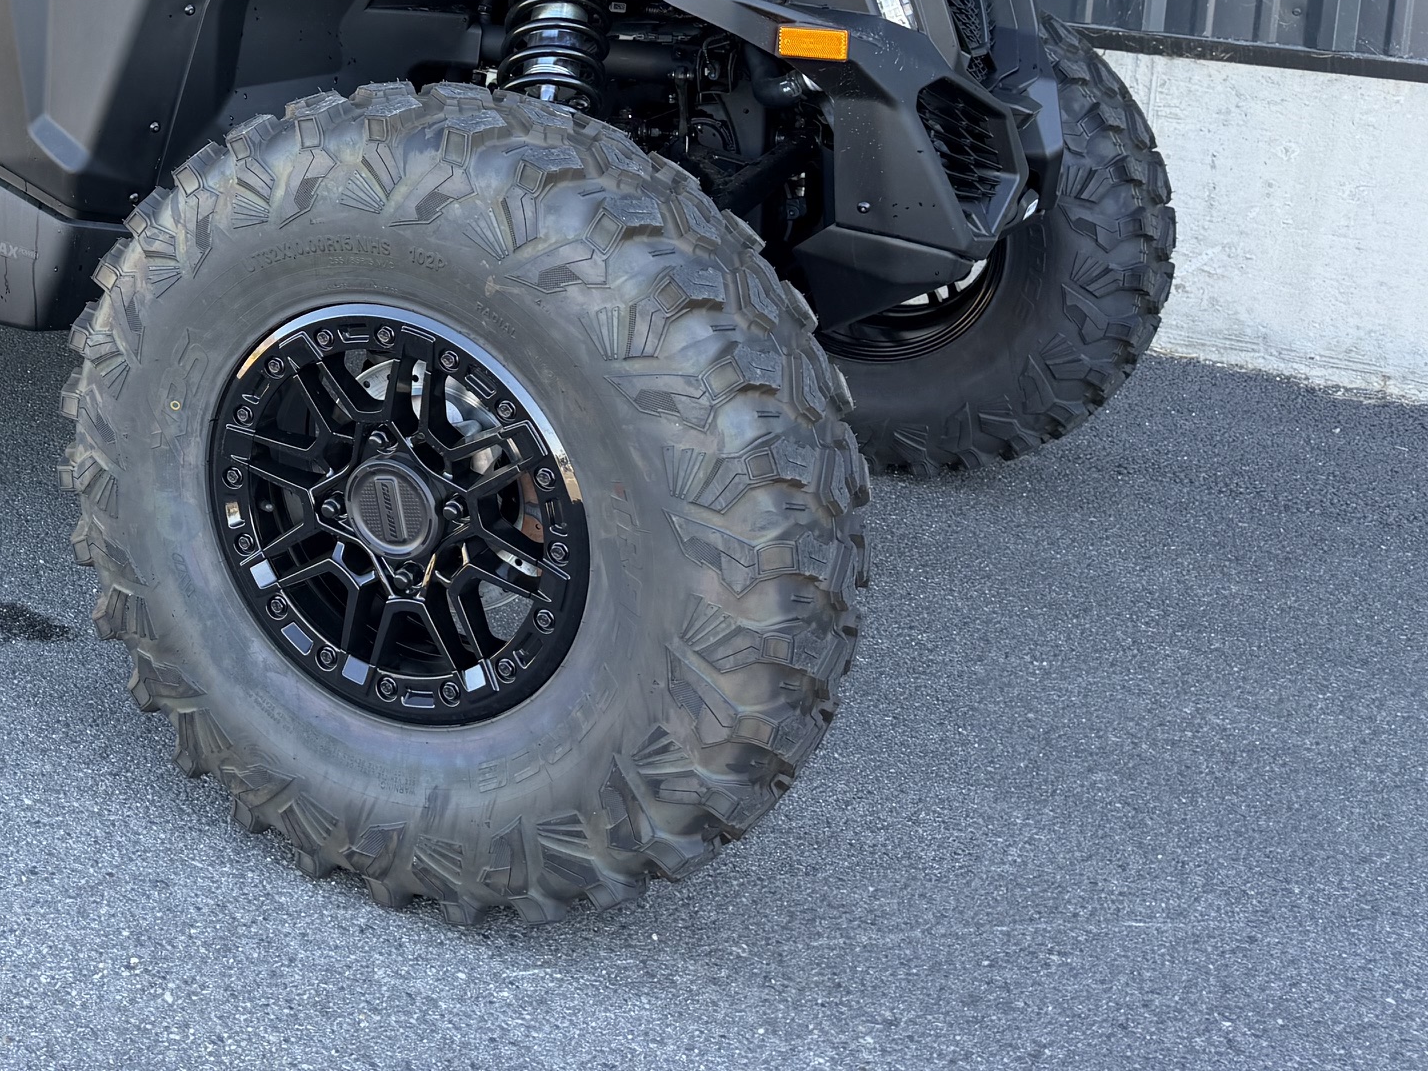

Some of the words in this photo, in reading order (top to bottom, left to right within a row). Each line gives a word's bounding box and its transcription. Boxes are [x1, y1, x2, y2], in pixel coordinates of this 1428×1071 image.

[355, 234, 391, 256] NHS
[409, 246, 448, 272] 102P
[475, 299, 518, 340] RADIAL
